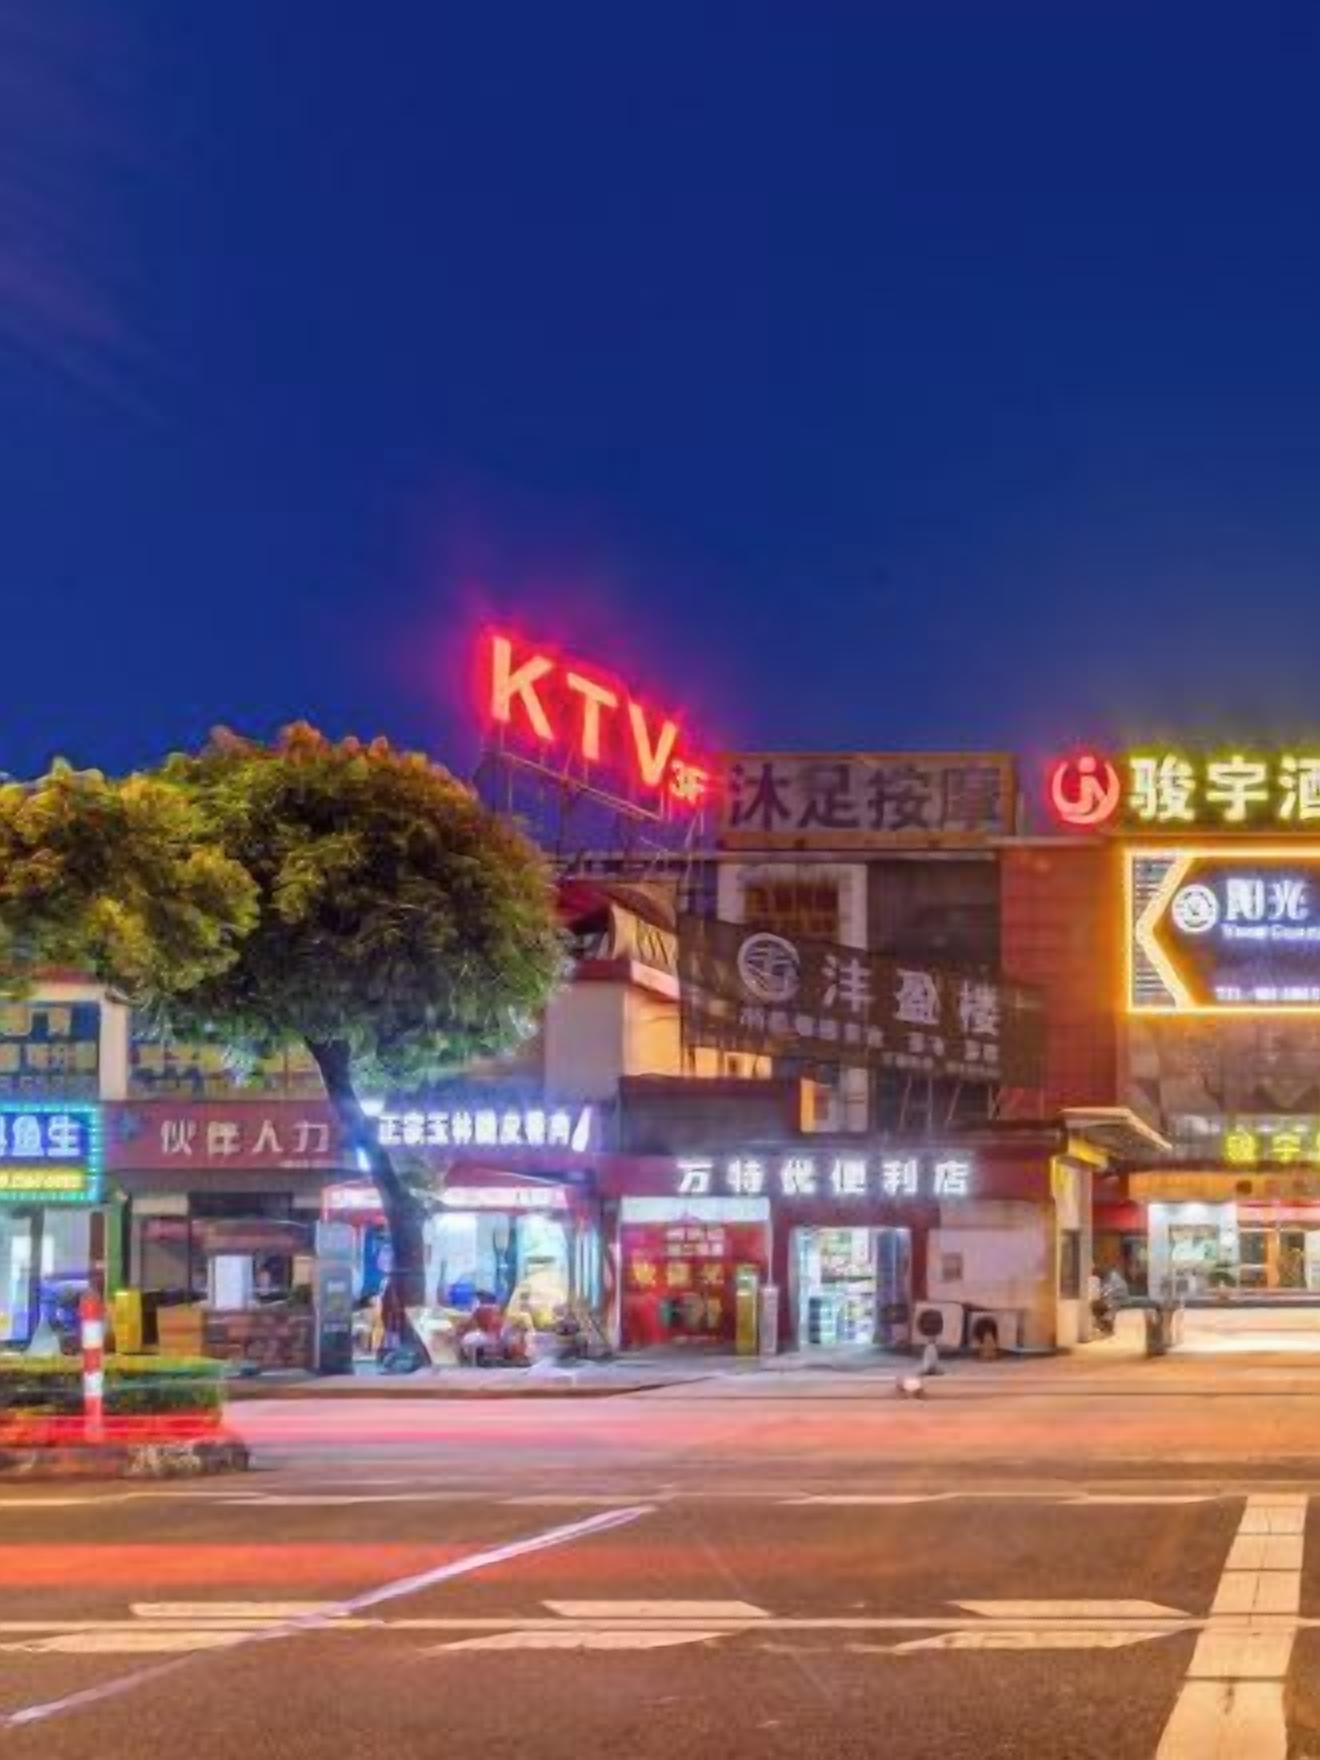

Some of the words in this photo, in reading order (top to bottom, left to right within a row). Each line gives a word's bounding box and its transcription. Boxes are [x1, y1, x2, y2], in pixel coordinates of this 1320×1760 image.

[492, 635, 677, 786] KTV
[728, 762, 1002, 832] 沐足按摩
[0, 1114, 81, 1156] 鱼生
[160, 1117, 331, 1158] 伙伴人力
